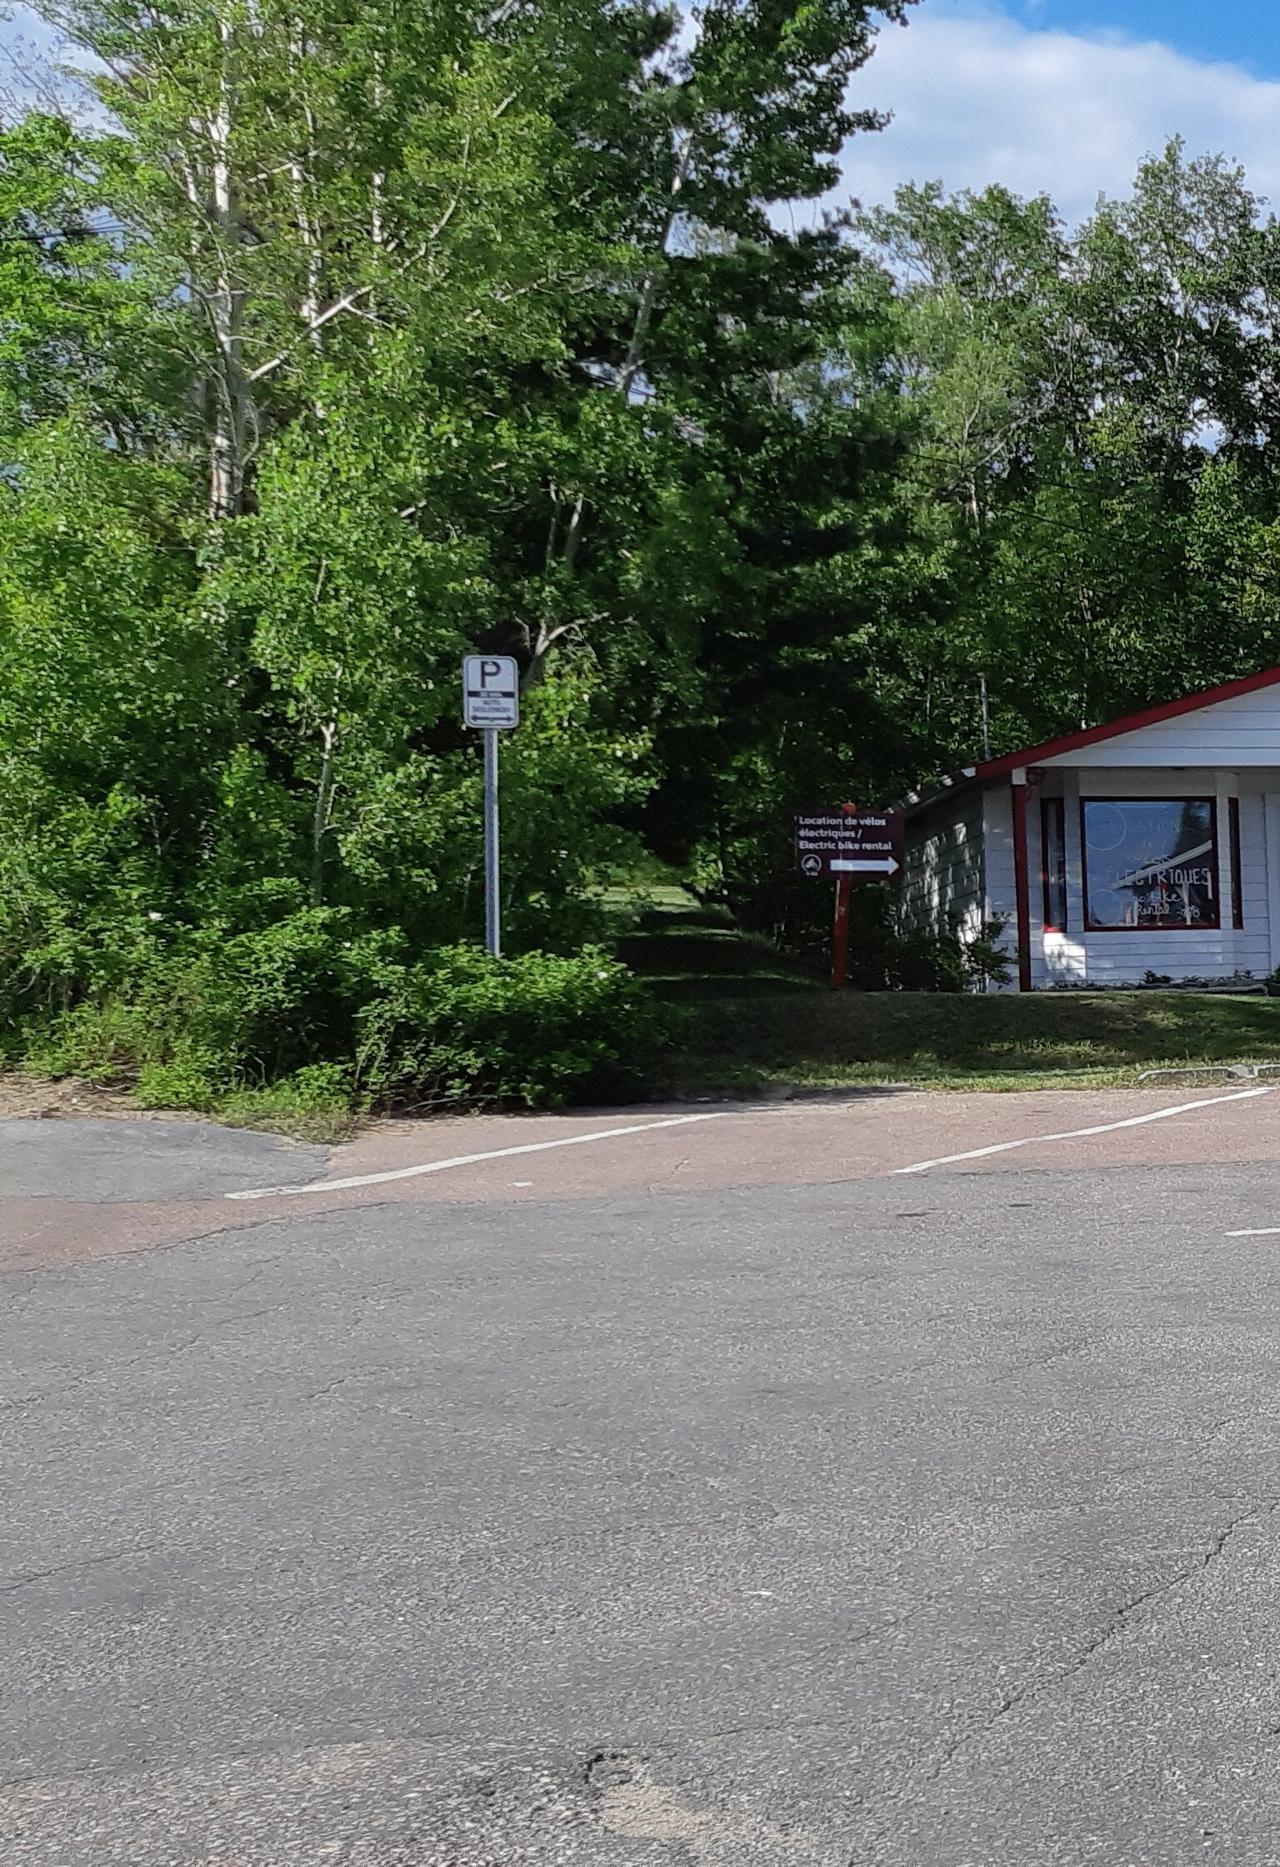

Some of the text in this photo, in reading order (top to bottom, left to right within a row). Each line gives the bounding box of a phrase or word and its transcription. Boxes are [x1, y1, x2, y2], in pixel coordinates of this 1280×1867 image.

[481, 661, 501, 688] P
[799, 816, 886, 825] Location de vélos
[799, 828, 855, 839] électriques
[799, 841, 892, 850] Electric bike rental
